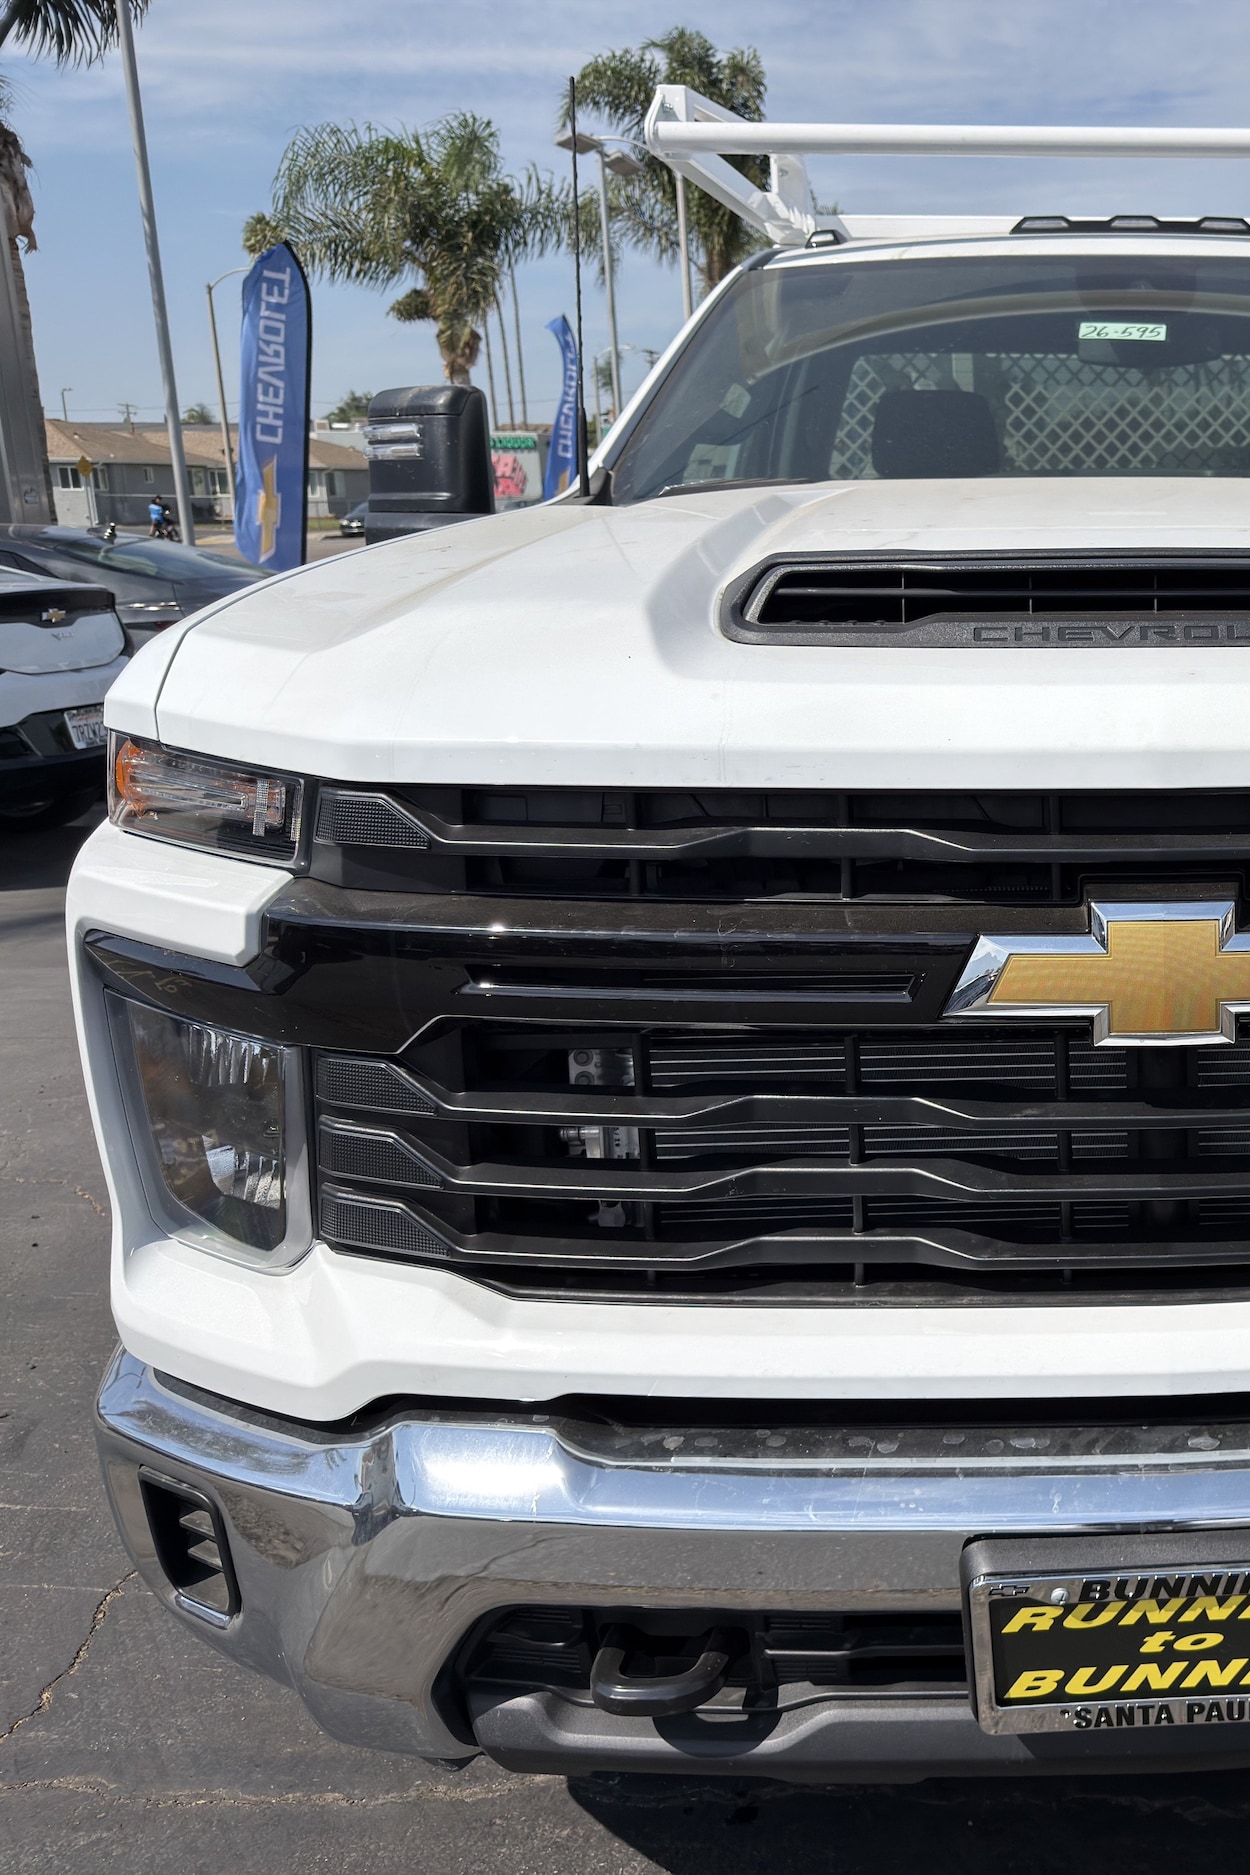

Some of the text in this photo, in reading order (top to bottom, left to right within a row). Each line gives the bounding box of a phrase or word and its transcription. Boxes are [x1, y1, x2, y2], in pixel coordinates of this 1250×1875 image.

[1081, 325, 1163, 338] 26-595
[1139, 1631, 1225, 1653] to
[1073, 1702, 1175, 1729] SANTA
